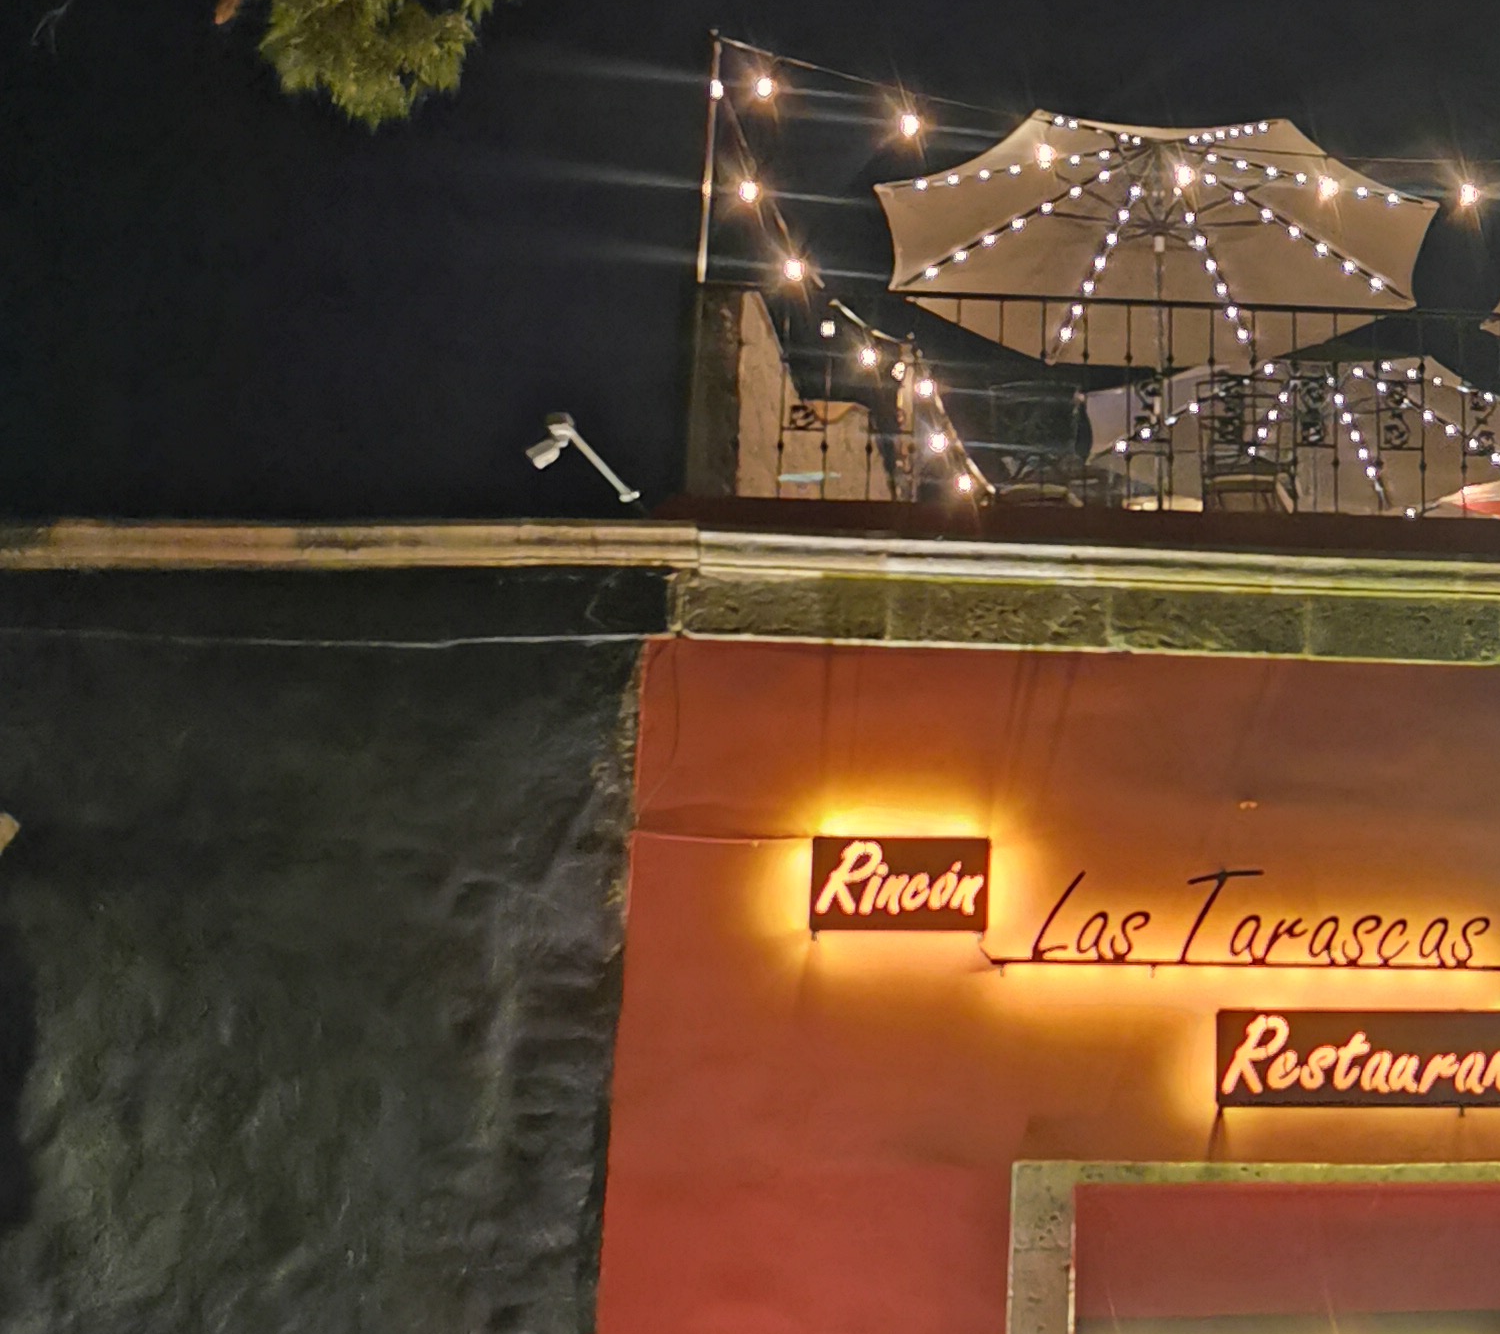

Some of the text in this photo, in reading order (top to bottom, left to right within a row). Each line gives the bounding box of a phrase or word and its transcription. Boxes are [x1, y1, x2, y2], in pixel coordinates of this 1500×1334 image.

[815, 840, 985, 915] Rincón
[1032, 869, 1491, 965] Las Tarascas
